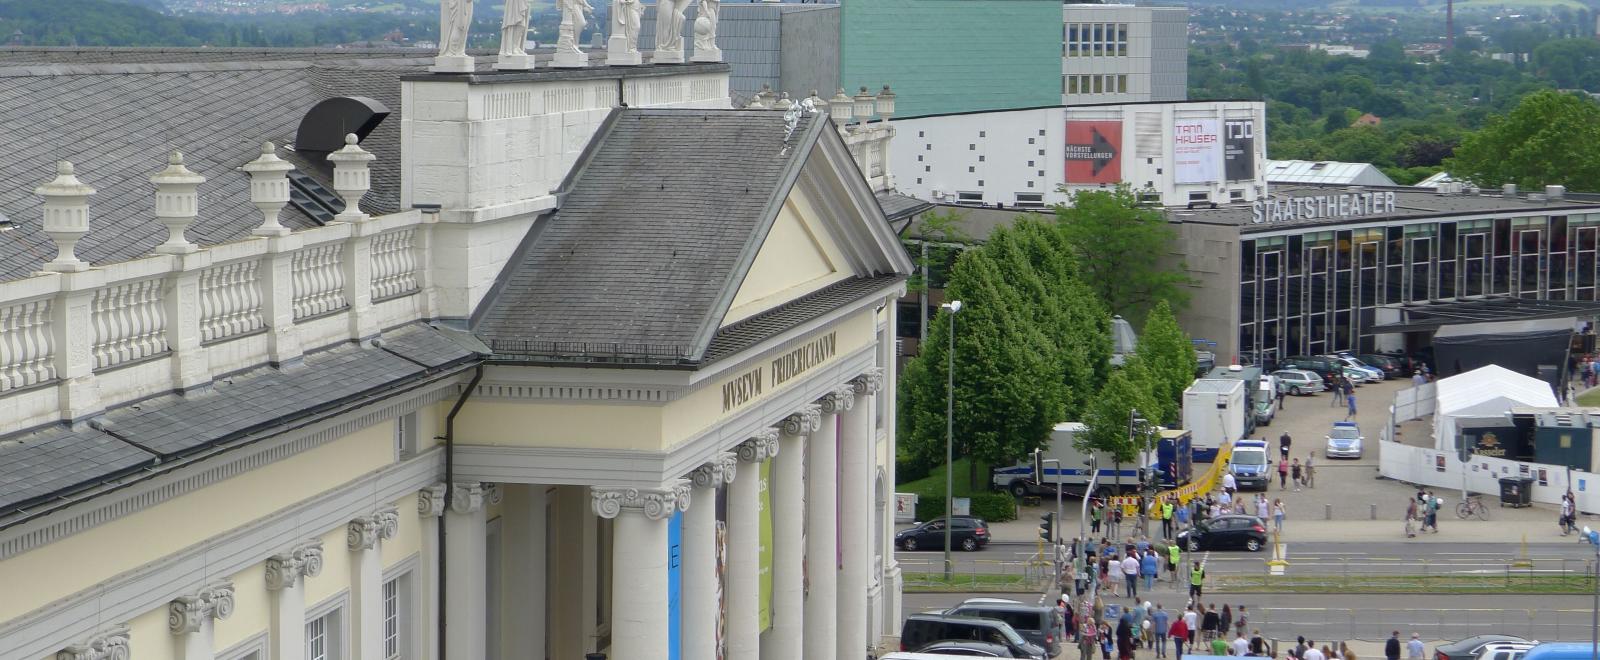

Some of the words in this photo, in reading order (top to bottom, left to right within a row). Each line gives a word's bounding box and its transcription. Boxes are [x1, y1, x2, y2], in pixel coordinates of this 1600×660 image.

[1175, 124, 1203, 134] TANN
[1175, 134, 1217, 144] HAUSER
[1252, 191, 1396, 223] STAATSTHEATER
[722, 366, 762, 413] MVSEVM
[771, 331, 837, 388] FRIDERICIANVM
